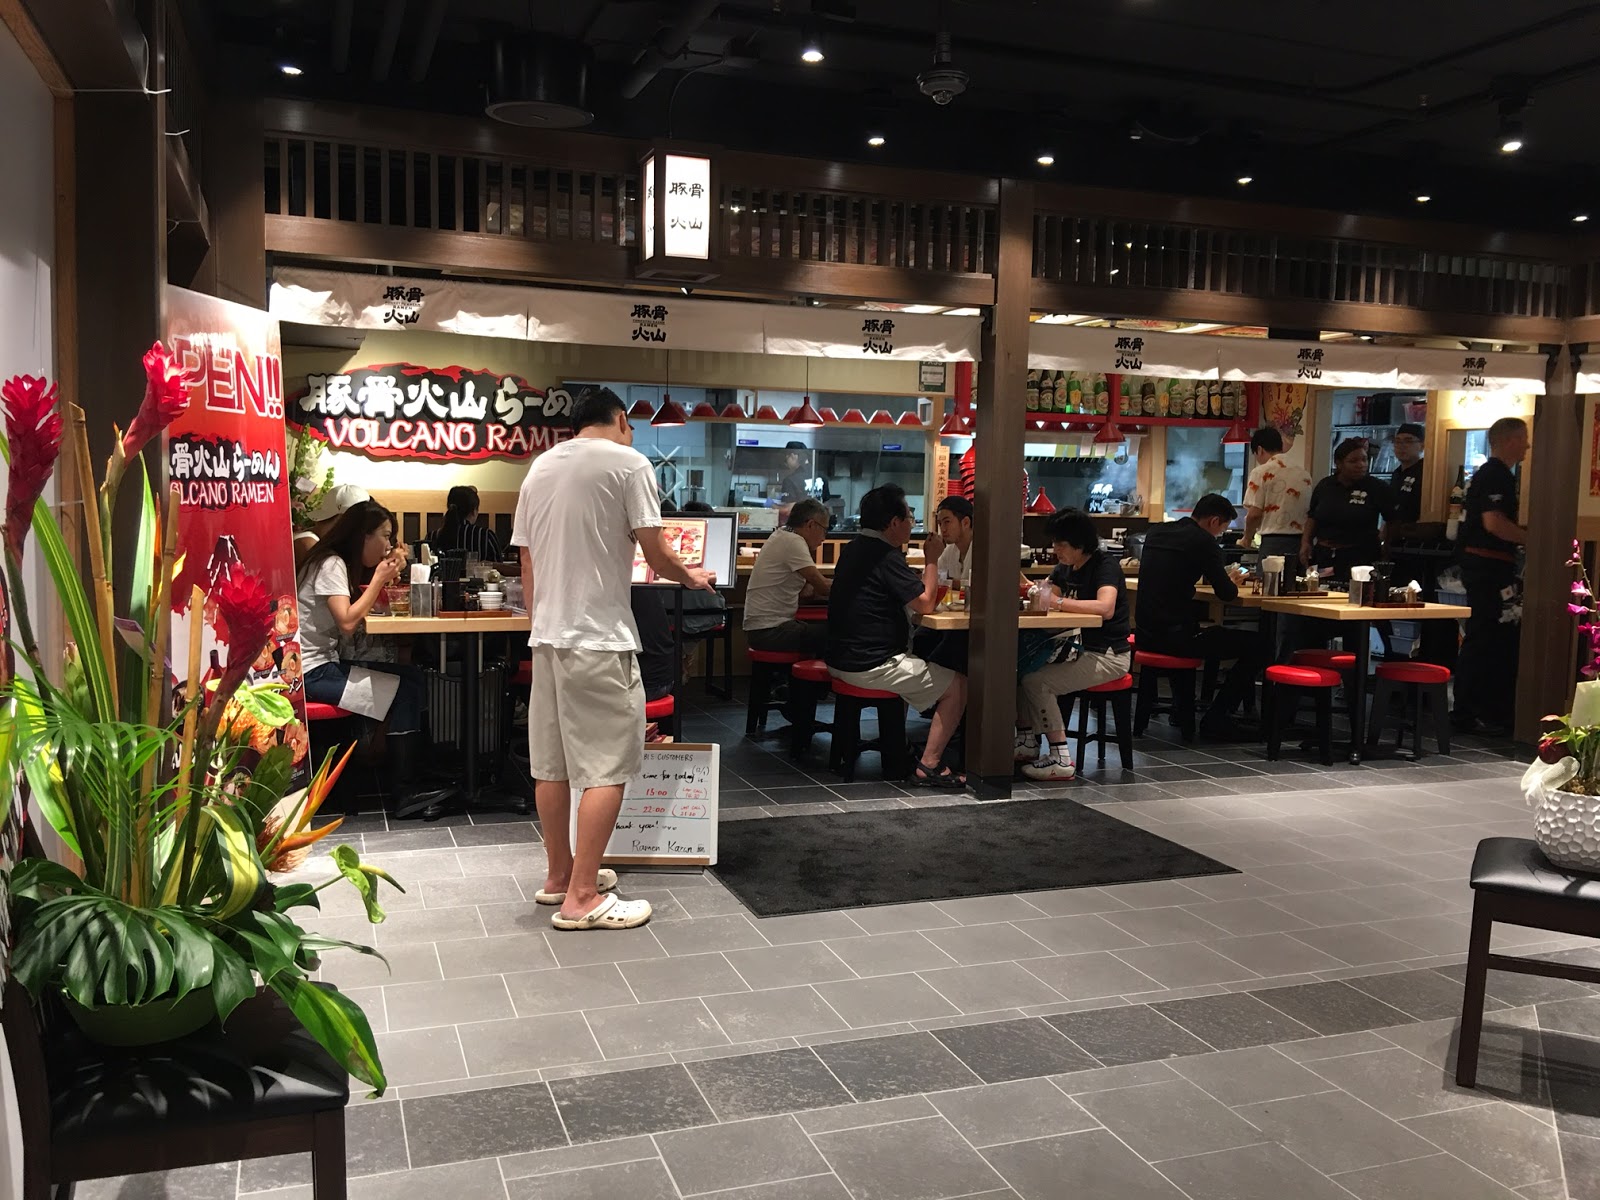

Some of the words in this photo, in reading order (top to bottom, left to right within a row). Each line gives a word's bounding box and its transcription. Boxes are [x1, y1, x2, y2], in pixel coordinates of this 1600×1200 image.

[668, 182, 704, 199] 豚骨
[670, 216, 702, 230] 火山
[383, 286, 425, 302] 豚骨
[383, 309, 420, 324] 火山
[631, 304, 669, 320] 豚骨
[862, 319, 895, 334] 豚骨
[631, 327, 667, 342] 火山
[862, 340, 893, 354] 火山
[1115, 336, 1144, 351] 豚骨
[1297, 348, 1324, 362] 豚骨
[1115, 356, 1142, 370] 火山
[1462, 357, 1487, 371] 豚骨
[168, 333, 283, 420] PEN!!
[1297, 366, 1322, 379] 火山
[1462, 374, 1485, 387] 火山
[300, 375, 574, 425] 豚骨火山らーめ
[324, 418, 475, 451] VOLCANO
[487, 424, 573, 451] RAME
[169, 442, 281, 482] 骨火山らーめん
[169, 482, 228, 505] OLCANO
[231, 482, 275, 504] RAMEN
[657, 753, 694, 761] CUSTOMERS
[674, 771, 694, 784] today
[642, 804, 666, 814] 22:00
[615, 821, 632, 830] hank
[632, 840, 661, 852] Ramen
